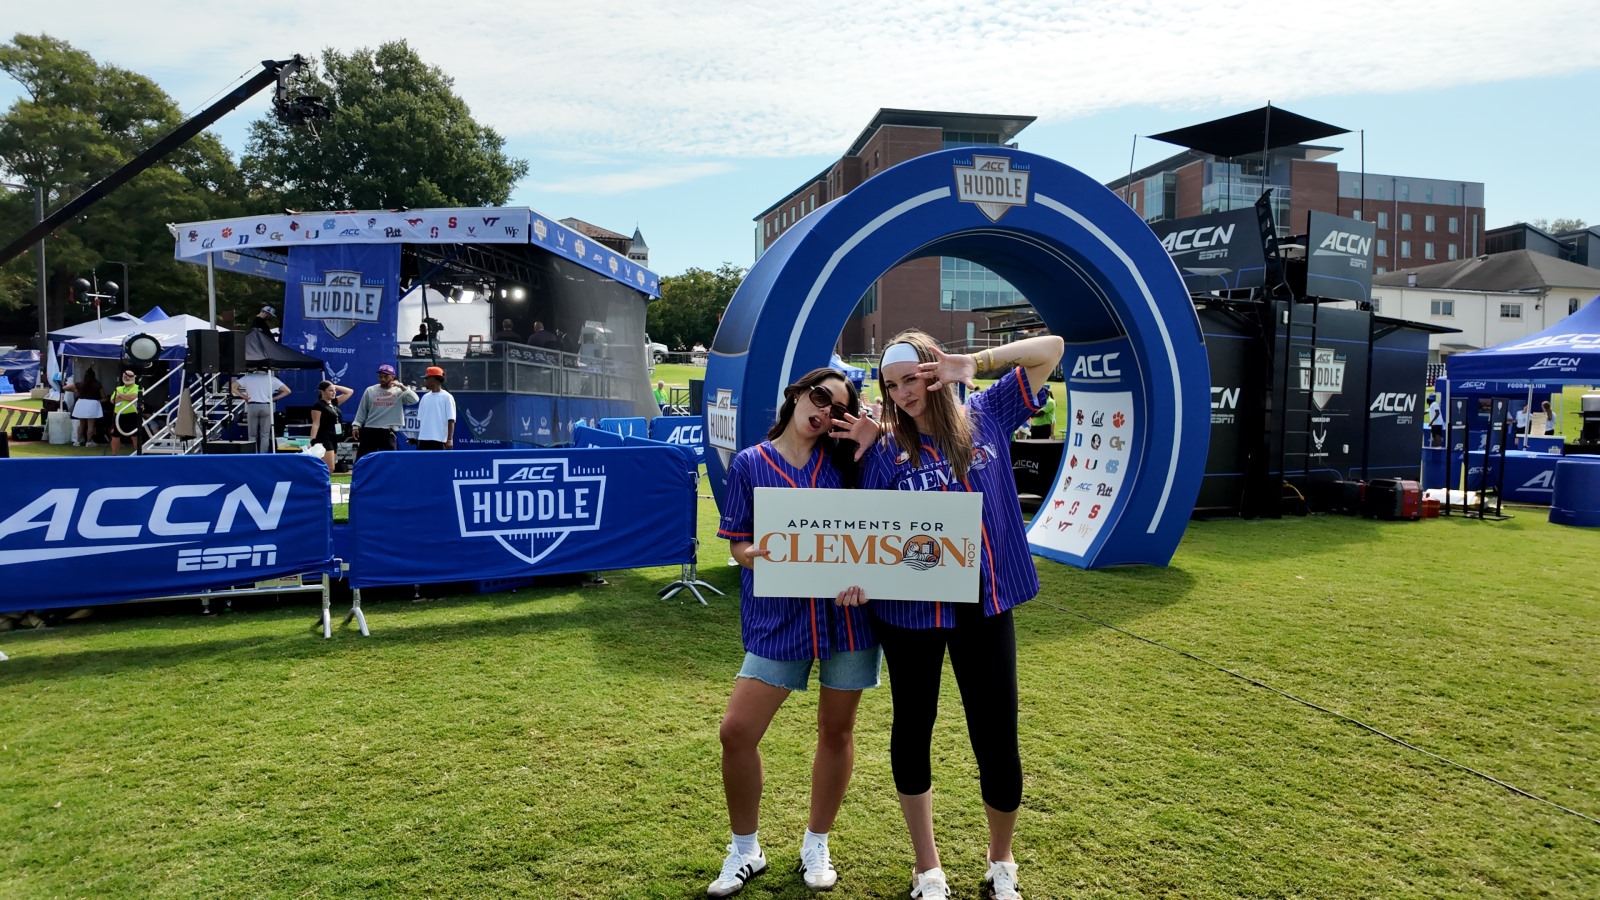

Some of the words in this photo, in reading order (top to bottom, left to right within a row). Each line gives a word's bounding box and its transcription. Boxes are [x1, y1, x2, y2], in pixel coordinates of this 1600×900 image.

[979, 161, 1005, 172] ACC
[963, 174, 1022, 198] HUDDLE
[340, 228, 360, 236] ACC
[384, 226, 402, 239] Pitt
[1162, 223, 1235, 252] ACCN
[1320, 230, 1371, 256] ACCN
[1198, 249, 1228, 260] ESPN
[328, 275, 357, 287] ACC
[310, 291, 375, 315] HUDDLE
[1072, 352, 1121, 378] ACC
[1533, 357, 1581, 366] ACCN
[1370, 392, 1417, 412] ACCN
[1091, 410, 1104, 427] Cal
[710, 413, 735, 442] HUDDLE
[906, 460, 951, 476] APARTME
[1013, 459, 1039, 470] ACCN
[504, 466, 559, 482] ACC
[1075, 482, 1093, 491] ACC
[1096, 483, 1113, 497] Pitt
[0, 481, 292, 542] ACCN
[473, 488, 590, 524] HUDDLE
[787, 519, 901, 531] APARTMENTS
[910, 522, 944, 532] FOR
[177, 544, 277, 572] ESPN
